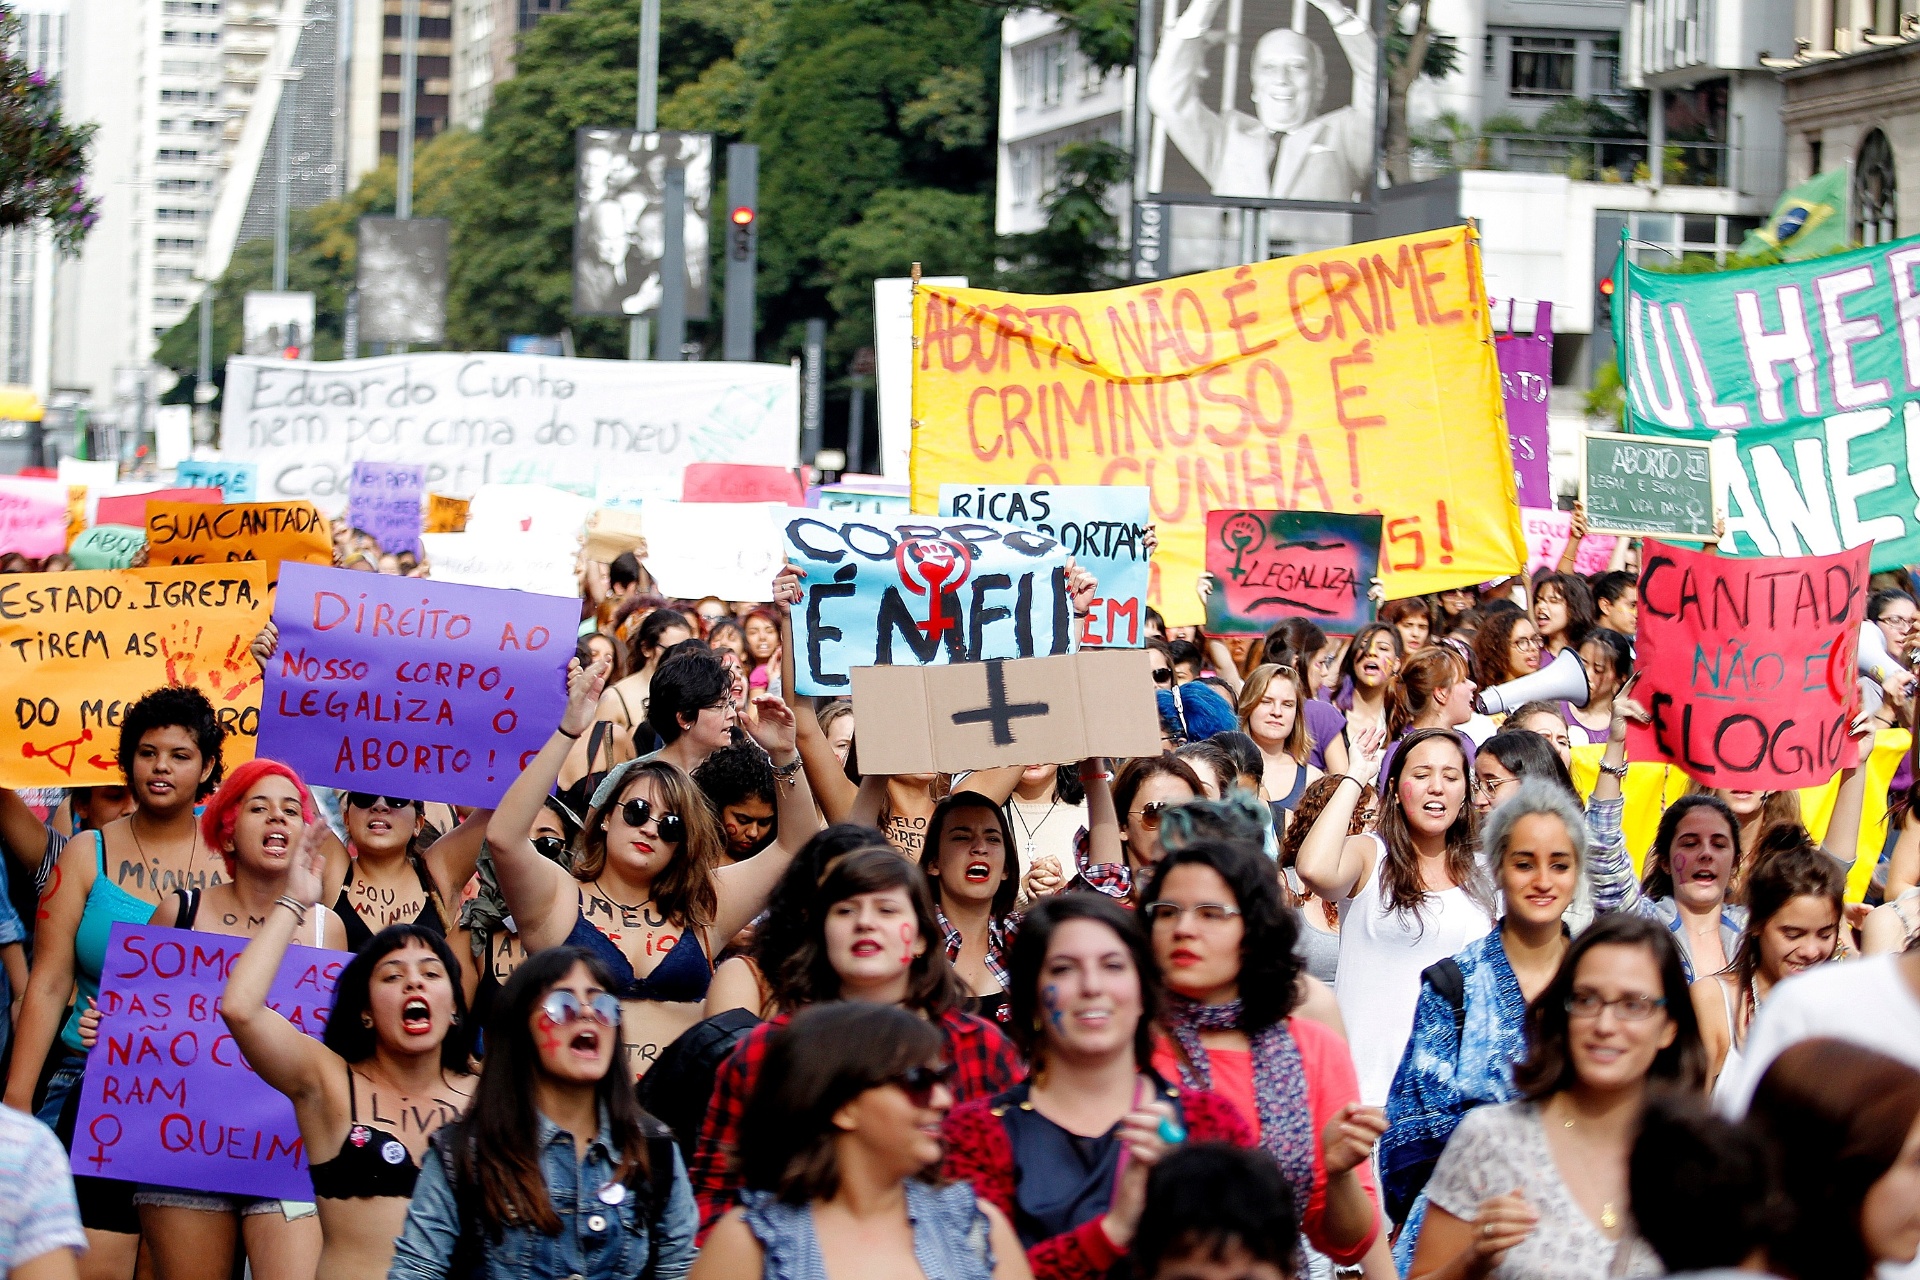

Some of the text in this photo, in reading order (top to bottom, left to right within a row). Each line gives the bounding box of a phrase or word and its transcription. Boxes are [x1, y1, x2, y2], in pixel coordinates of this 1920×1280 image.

[921, 240, 1480, 375] ABORTO NÃO É CRIME!
[250, 360, 575, 411] Eduardo Cunha
[967, 339, 1386, 461] CRIMINOSO É
[250, 414, 328, 448] nem
[347, 416, 416, 462] por
[534, 405, 576, 445] do
[594, 417, 681, 452] meu
[1611, 446, 1681, 479] ABORTO
[1240, 560, 1364, 599] LEGALIZA
[125, 632, 158, 658] AS
[499, 621, 550, 651] AO
[281, 647, 369, 682] NOSSO
[1691, 638, 1785, 693] NÃO
[16, 697, 60, 730] DO
[355, 879, 395, 906] SOU
[586, 894, 667, 928] MEU
[101, 990, 172, 1018] DAS
[106, 1023, 199, 1068] NÃO
[102, 1074, 187, 1109] RAM
